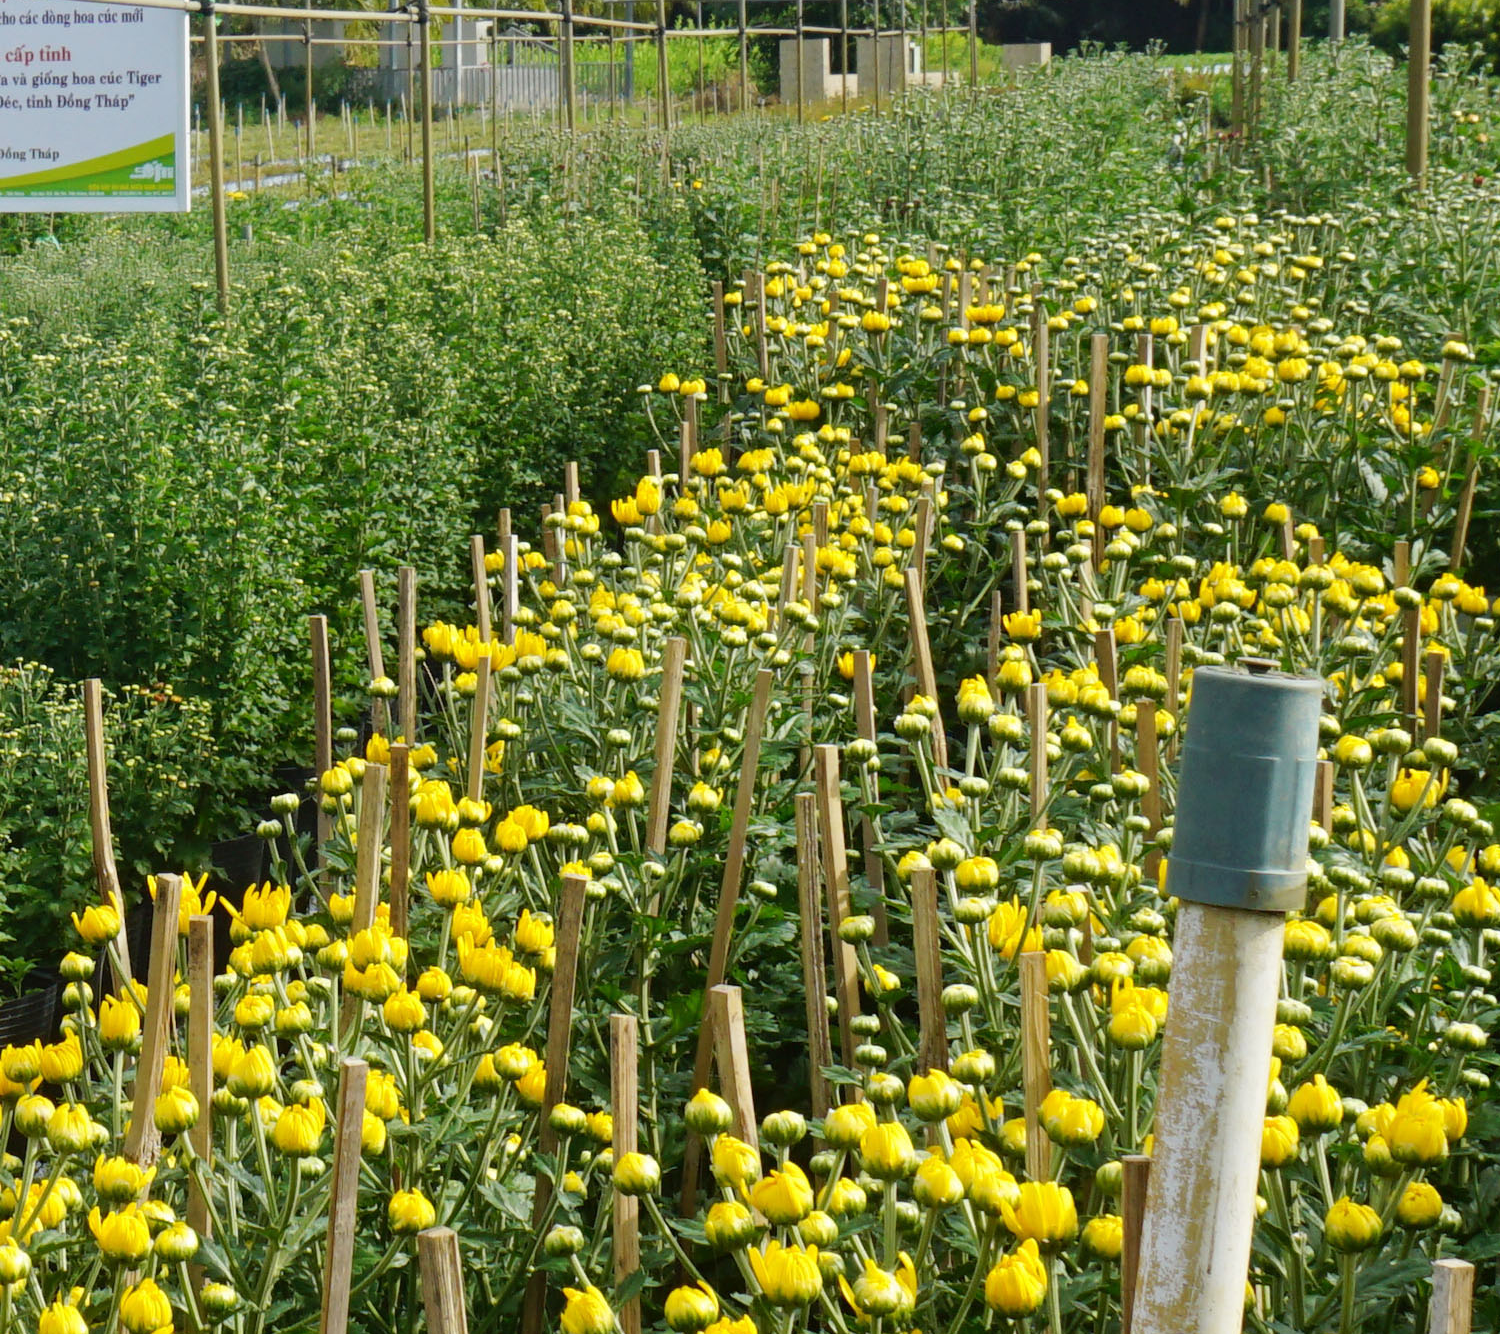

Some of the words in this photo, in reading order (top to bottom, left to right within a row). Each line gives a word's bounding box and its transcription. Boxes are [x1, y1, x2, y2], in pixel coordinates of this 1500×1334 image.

[19, 9, 38, 25] các
[42, 9, 71, 28] dòng
[74, 9, 94, 24] hoa
[98, 8, 117, 23] cúc
[121, 8, 144, 23] mới
[5, 44, 34, 66] cấp
[39, 45, 72, 62] tỉnh
[12, 72, 27, 86] và
[32, 70, 68, 88] giống
[72, 71, 95, 85] hoa
[100, 71, 123, 84] cúc
[126, 70, 162, 87] Tiger
[26, 94, 52, 108] tỉnh
[57, 92, 91, 110] Đồng
[29, 148, 60, 161] Tháp
